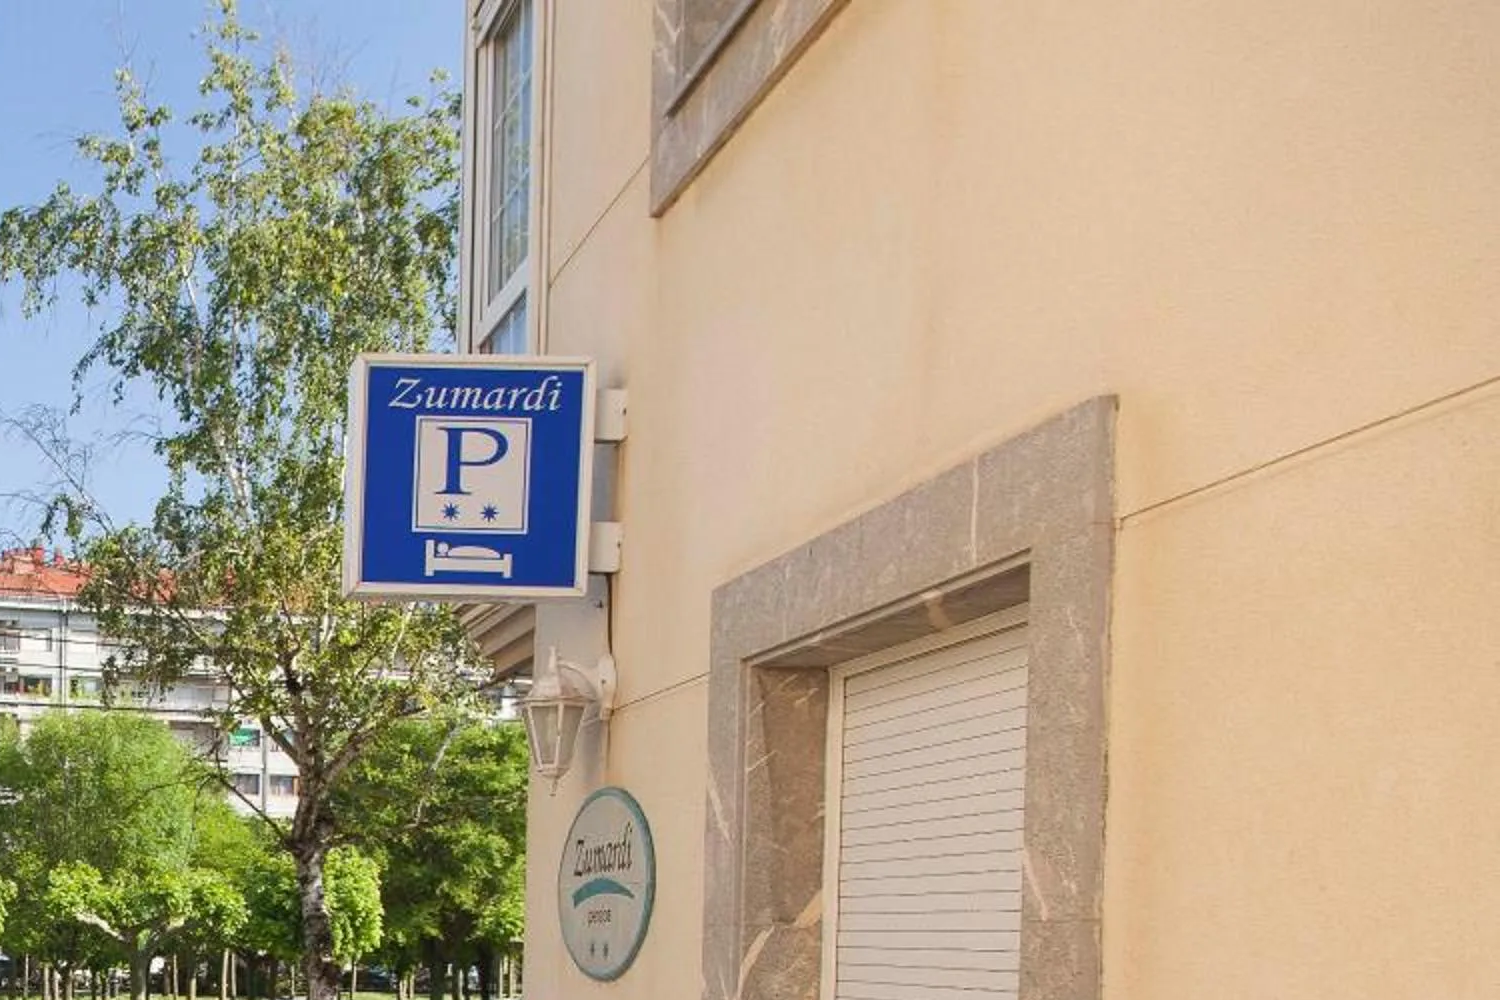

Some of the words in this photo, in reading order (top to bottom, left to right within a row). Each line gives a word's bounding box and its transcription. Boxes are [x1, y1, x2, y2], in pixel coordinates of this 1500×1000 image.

[388, 375, 563, 411] Zumardi
[434, 426, 509, 495] P
[573, 821, 633, 876] Zumardi
